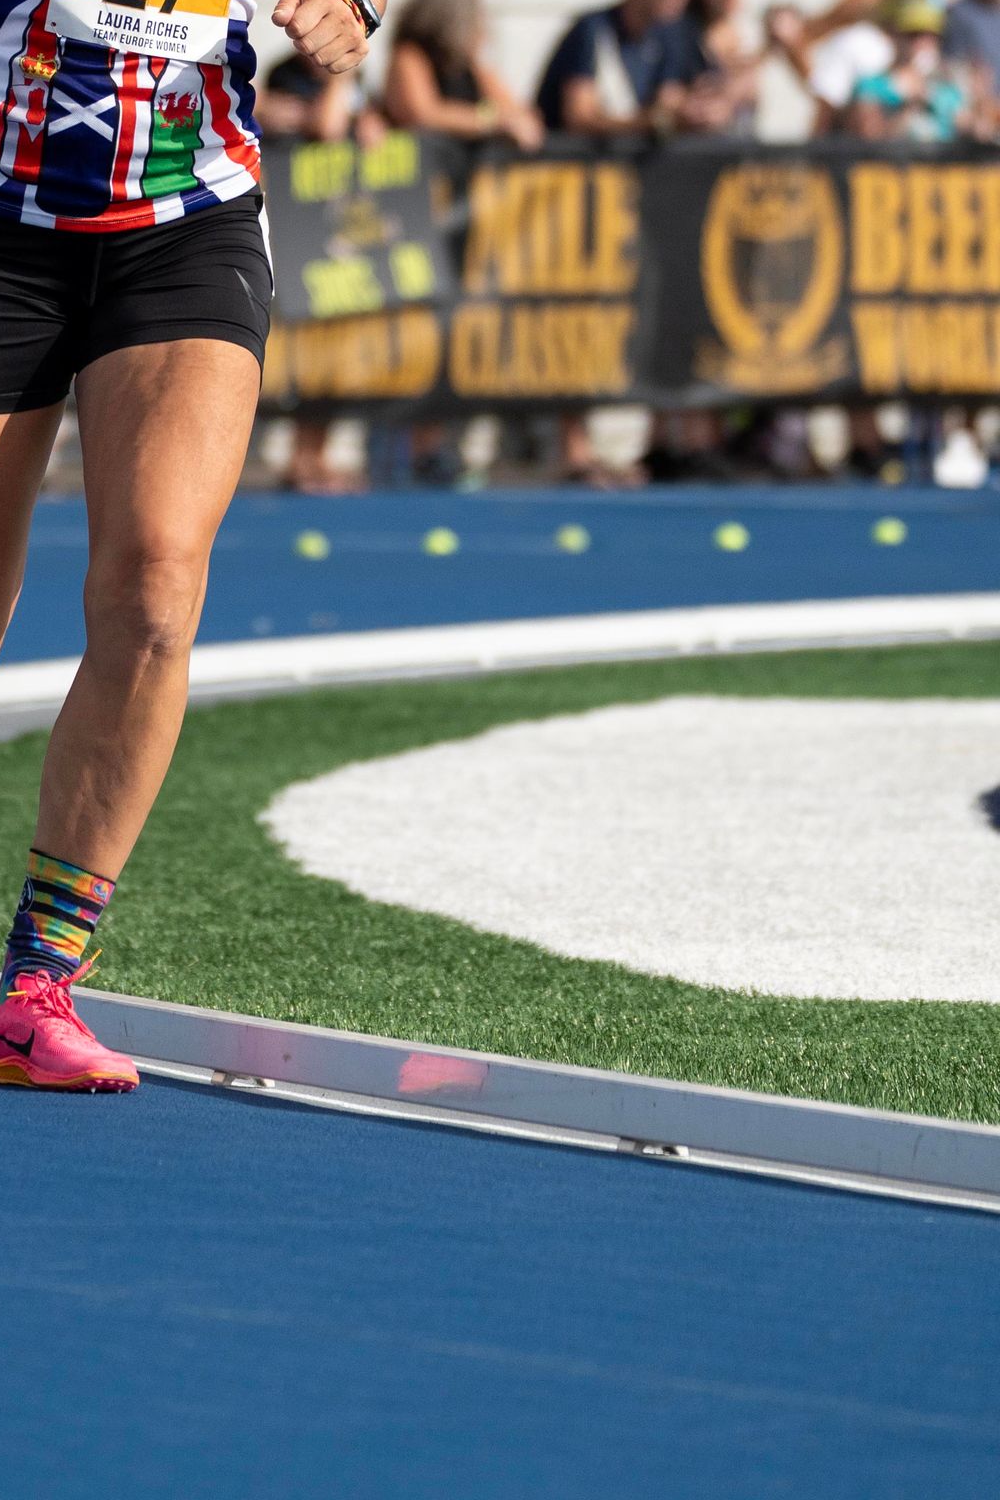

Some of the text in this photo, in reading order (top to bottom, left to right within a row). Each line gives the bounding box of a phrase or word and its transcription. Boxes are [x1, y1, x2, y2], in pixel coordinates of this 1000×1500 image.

[93, 27, 187, 54] TEAM EUROPE WOMEN
[96, 10, 189, 41] LAURA RICHES
[849, 160, 1000, 296] BEE
